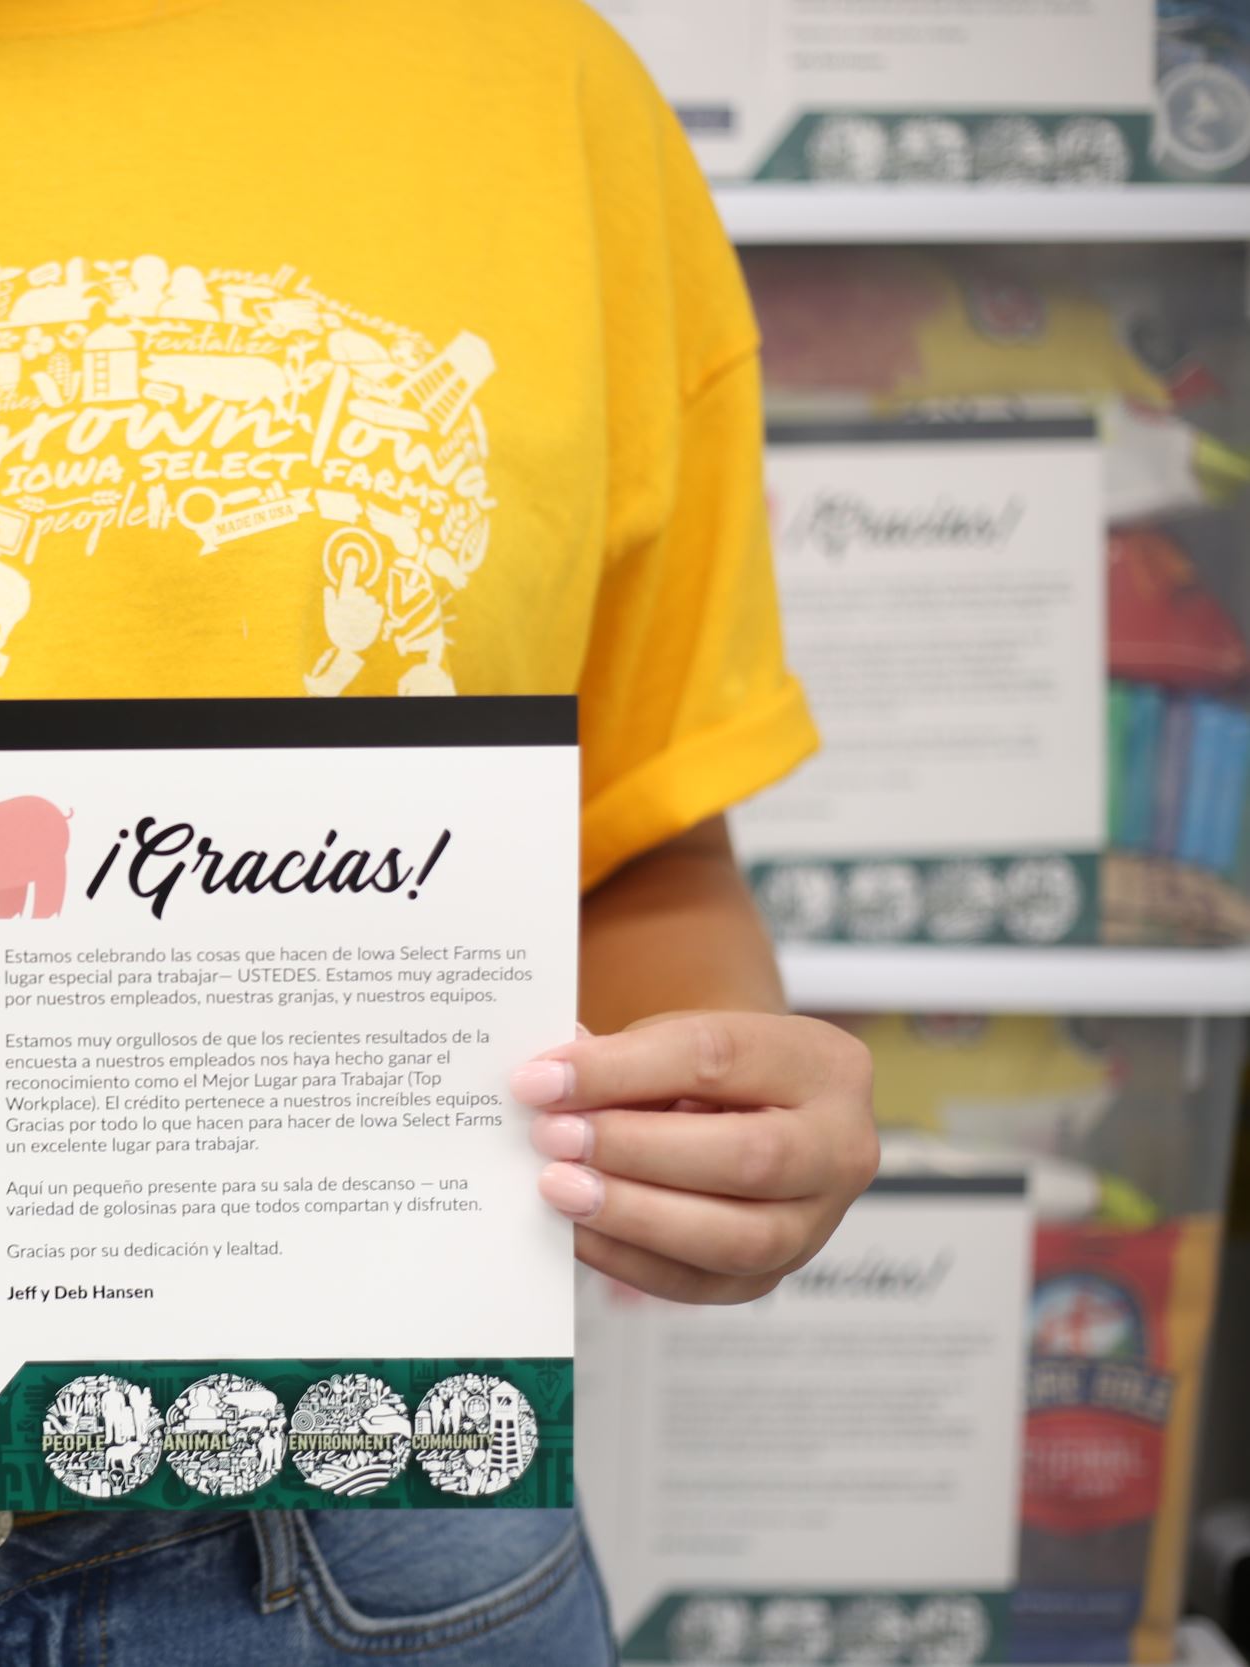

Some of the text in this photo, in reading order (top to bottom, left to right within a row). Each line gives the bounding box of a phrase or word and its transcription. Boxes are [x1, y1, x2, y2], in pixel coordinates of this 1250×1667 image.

[207, 263, 298, 287] small
[309, 361, 498, 510] Iowa
[1, 451, 450, 513] IOWA SELECT FARMS
[24, 480, 150, 566] people
[215, 514, 253, 537] MADE
[268, 504, 295, 522] USA
[85, 816, 452, 920] ¡Gracias!
[4, 946, 527, 967] Estamos celebrando las cosas que hacen de Iowa Select Farms un
[4, 967, 533, 990] lugar especial para trabajar— USTEDES. Estamos muy agradecidos
[4, 988, 497, 1011] por nuestros empleados, nuestras granjas, y nuestros equipos.
[5, 1179, 44, 1200] Aquí
[47, 1182, 68, 1195] un
[72, 1179, 144, 1199] pequeño
[147, 1180, 218, 1199] presente
[221, 1181, 257, 1198] para
[260, 1180, 279, 1193] su
[282, 1177, 314, 1193] sala
[317, 1177, 338, 1193] de
[341, 1177, 416, 1193] descanso
[438, 1179, 469, 1192] una
[5, 1197, 483, 1220] variedad de golosinas para que todos compartan y disfruten.
[6, 1241, 283, 1263] Gracias por su dedicación y lealtad.
[7, 1284, 154, 1305] Jeff y Deb Hansen
[41, 1433, 106, 1452] PEOPLE
[162, 1433, 232, 1451] ANIMAL
[288, 1432, 395, 1451] ENVIRONMENT
[411, 1432, 496, 1450] COMMUNITY
[44, 1449, 96, 1464] care
[164, 1449, 217, 1463] care
[291, 1449, 343, 1462] care
[414, 1448, 466, 1462] care
